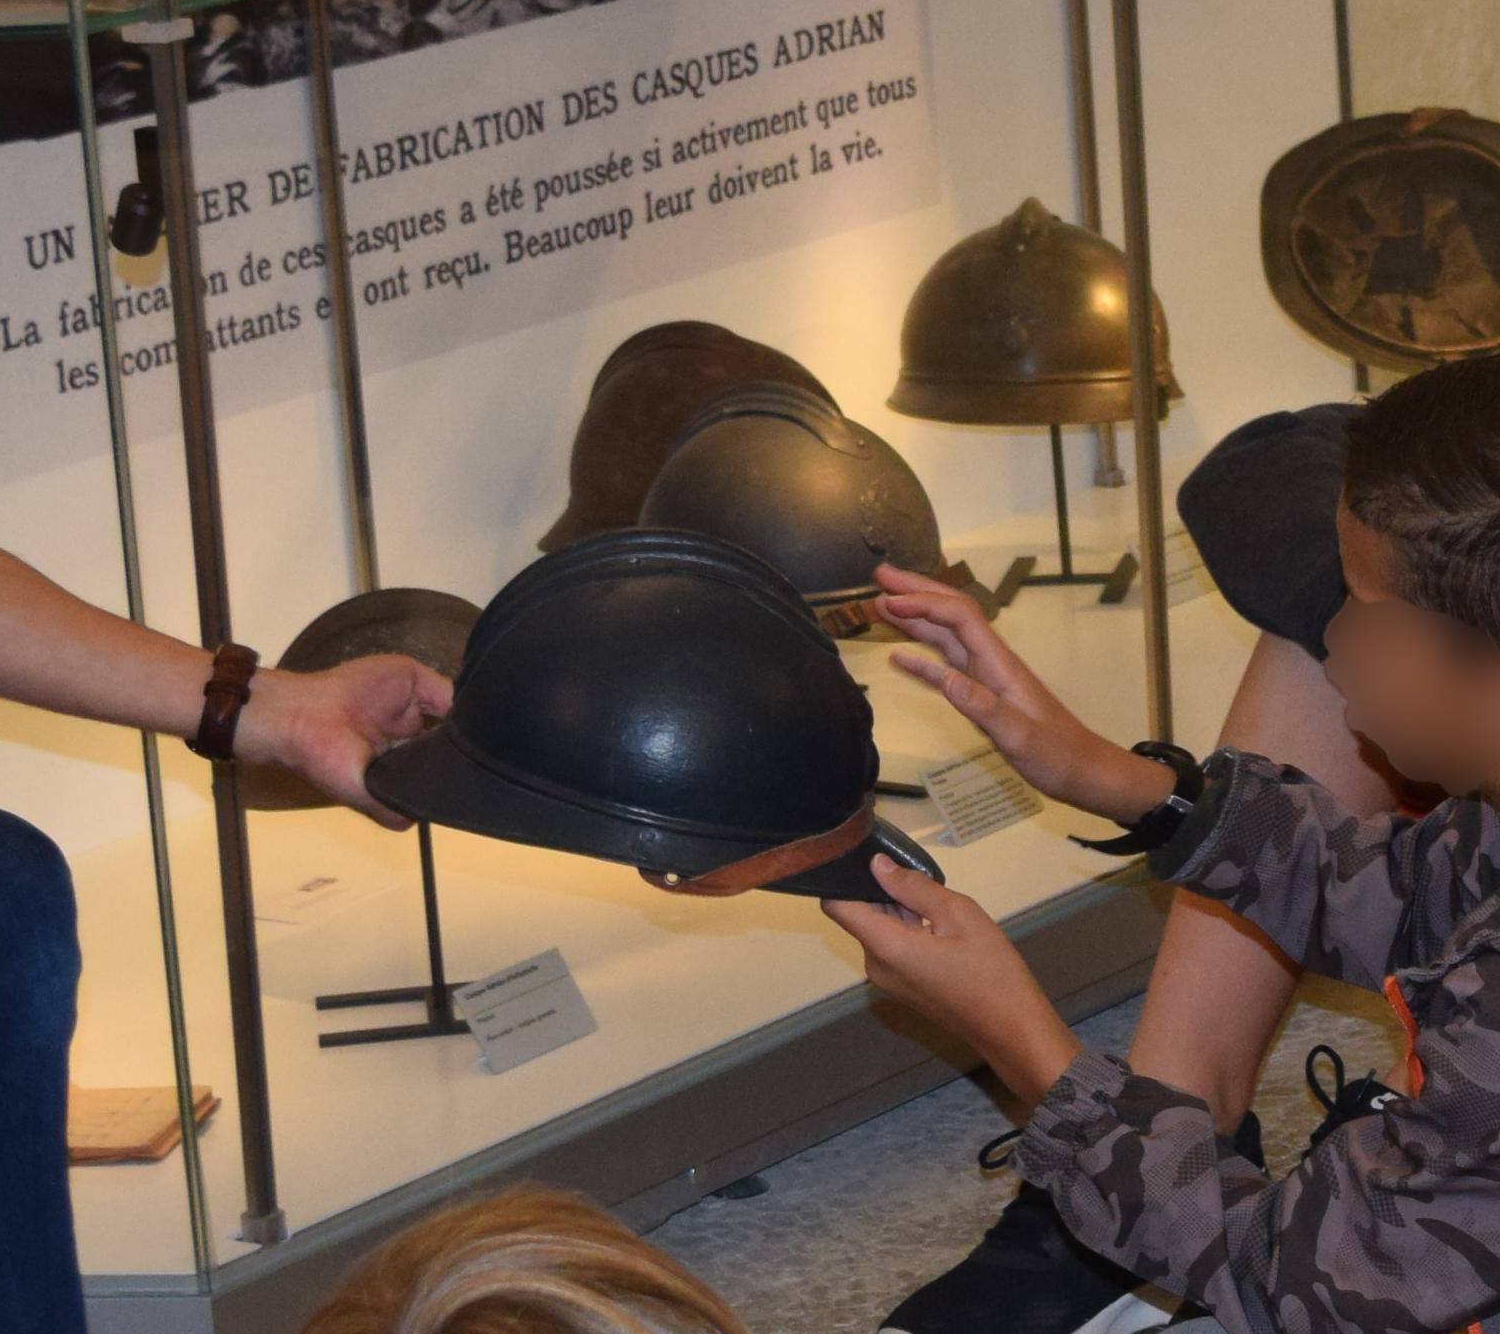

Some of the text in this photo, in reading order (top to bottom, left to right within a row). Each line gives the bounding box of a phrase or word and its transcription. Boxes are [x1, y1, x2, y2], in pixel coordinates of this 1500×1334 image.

[0, 317, 43, 351] La
[240, 254, 273, 288] de
[283, 242, 326, 274] ces
[345, 207, 447, 258] asques
[460, 200, 477, 225] a
[485, 177, 525, 217] été
[534, 150, 634, 212] poussée
[642, 137, 663, 172] si
[673, 99, 809, 164] activement
[816, 91, 860, 129] que
[867, 75, 918, 108] tous
[25, 226, 75, 269] UN
[268, 164, 315, 207] DE
[562, 81, 619, 126] DES
[633, 42, 759, 105] CASQUES
[773, 10, 886, 67] ADRIAN
[56, 359, 100, 394] les
[120, 302, 301, 377] comattants
[364, 267, 411, 306] ont
[424, 251, 491, 289] reçu.
[504, 207, 633, 265] Beaucoup
[645, 185, 696, 223] leur
[708, 153, 800, 205] doivent
[810, 143, 834, 176] la
[841, 131, 884, 163] vie.
